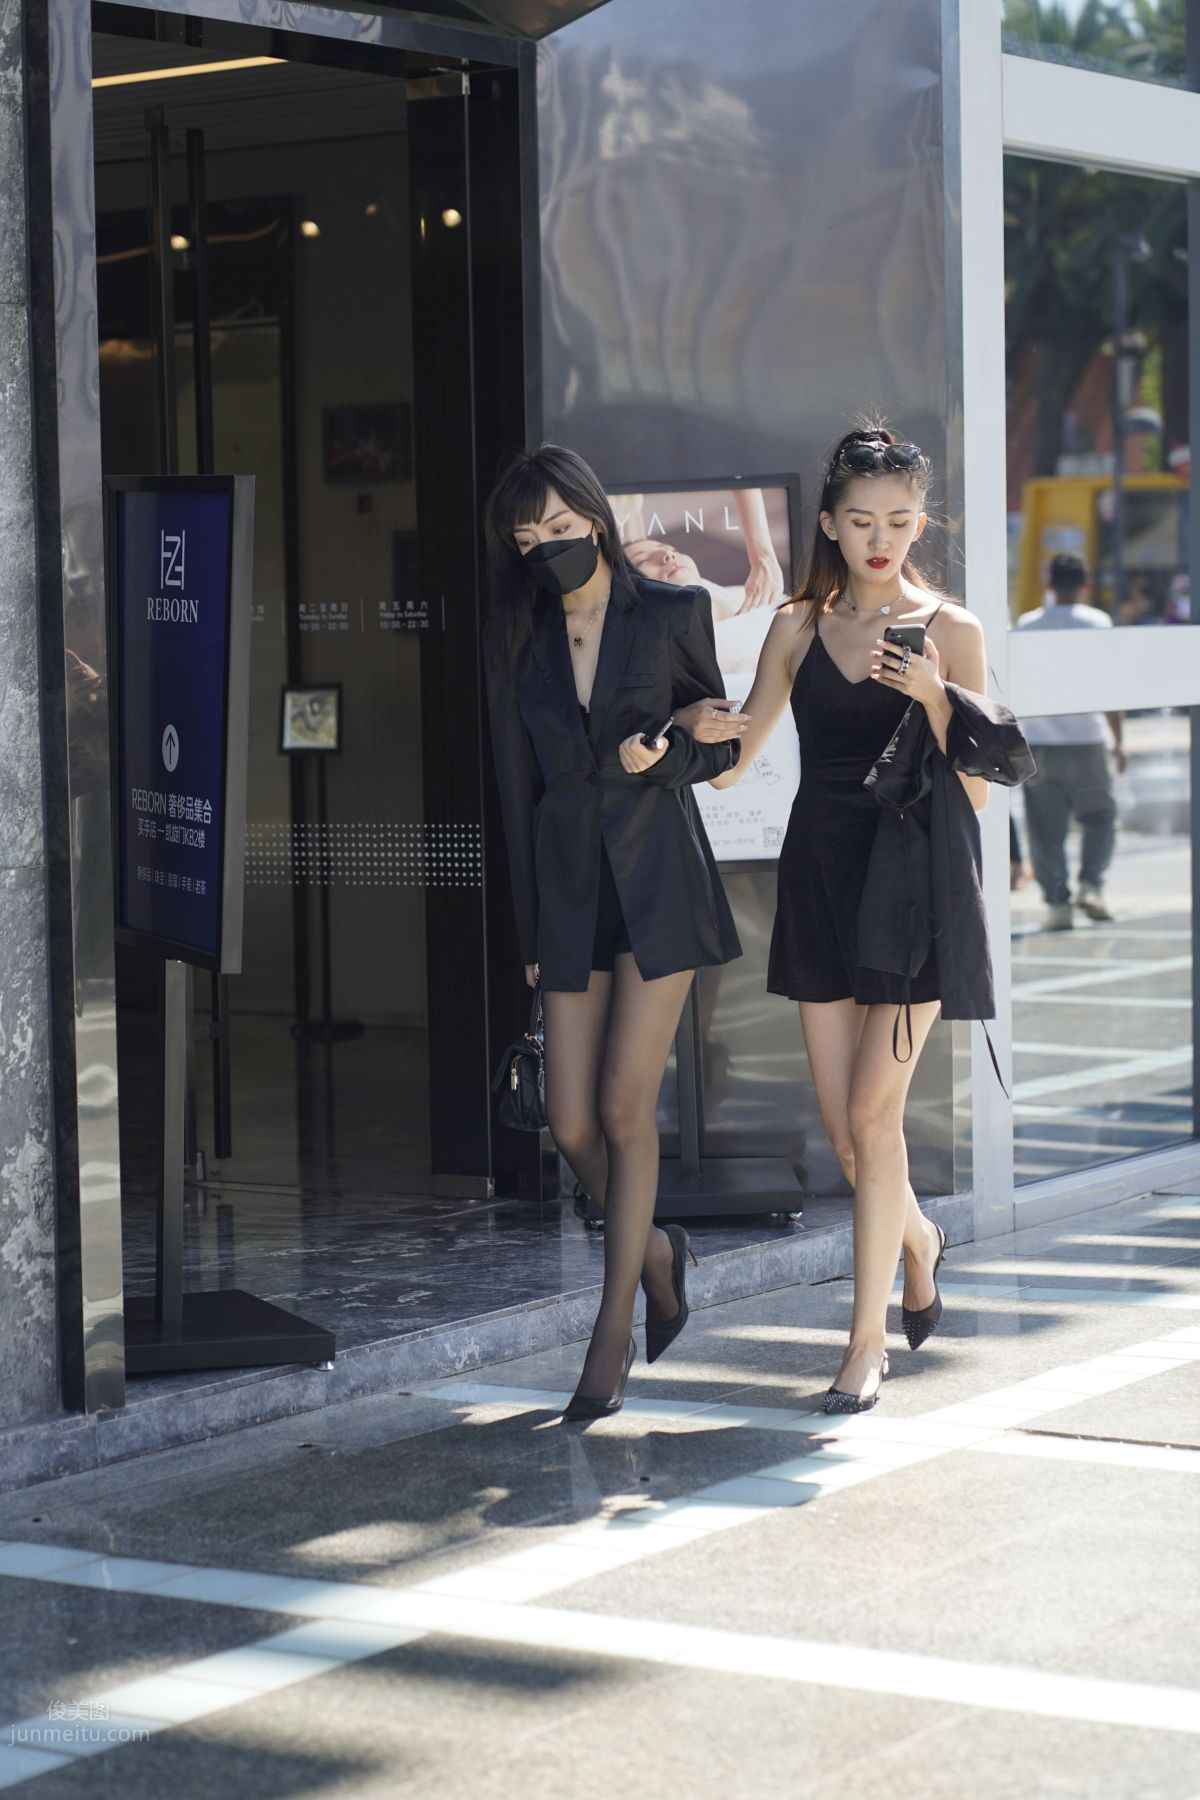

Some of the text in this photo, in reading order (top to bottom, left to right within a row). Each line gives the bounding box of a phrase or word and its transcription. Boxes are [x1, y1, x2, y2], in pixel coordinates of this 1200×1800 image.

[147, 597, 199, 624] REBORN
[132, 787, 212, 825] REBORN 奢侈品集合
